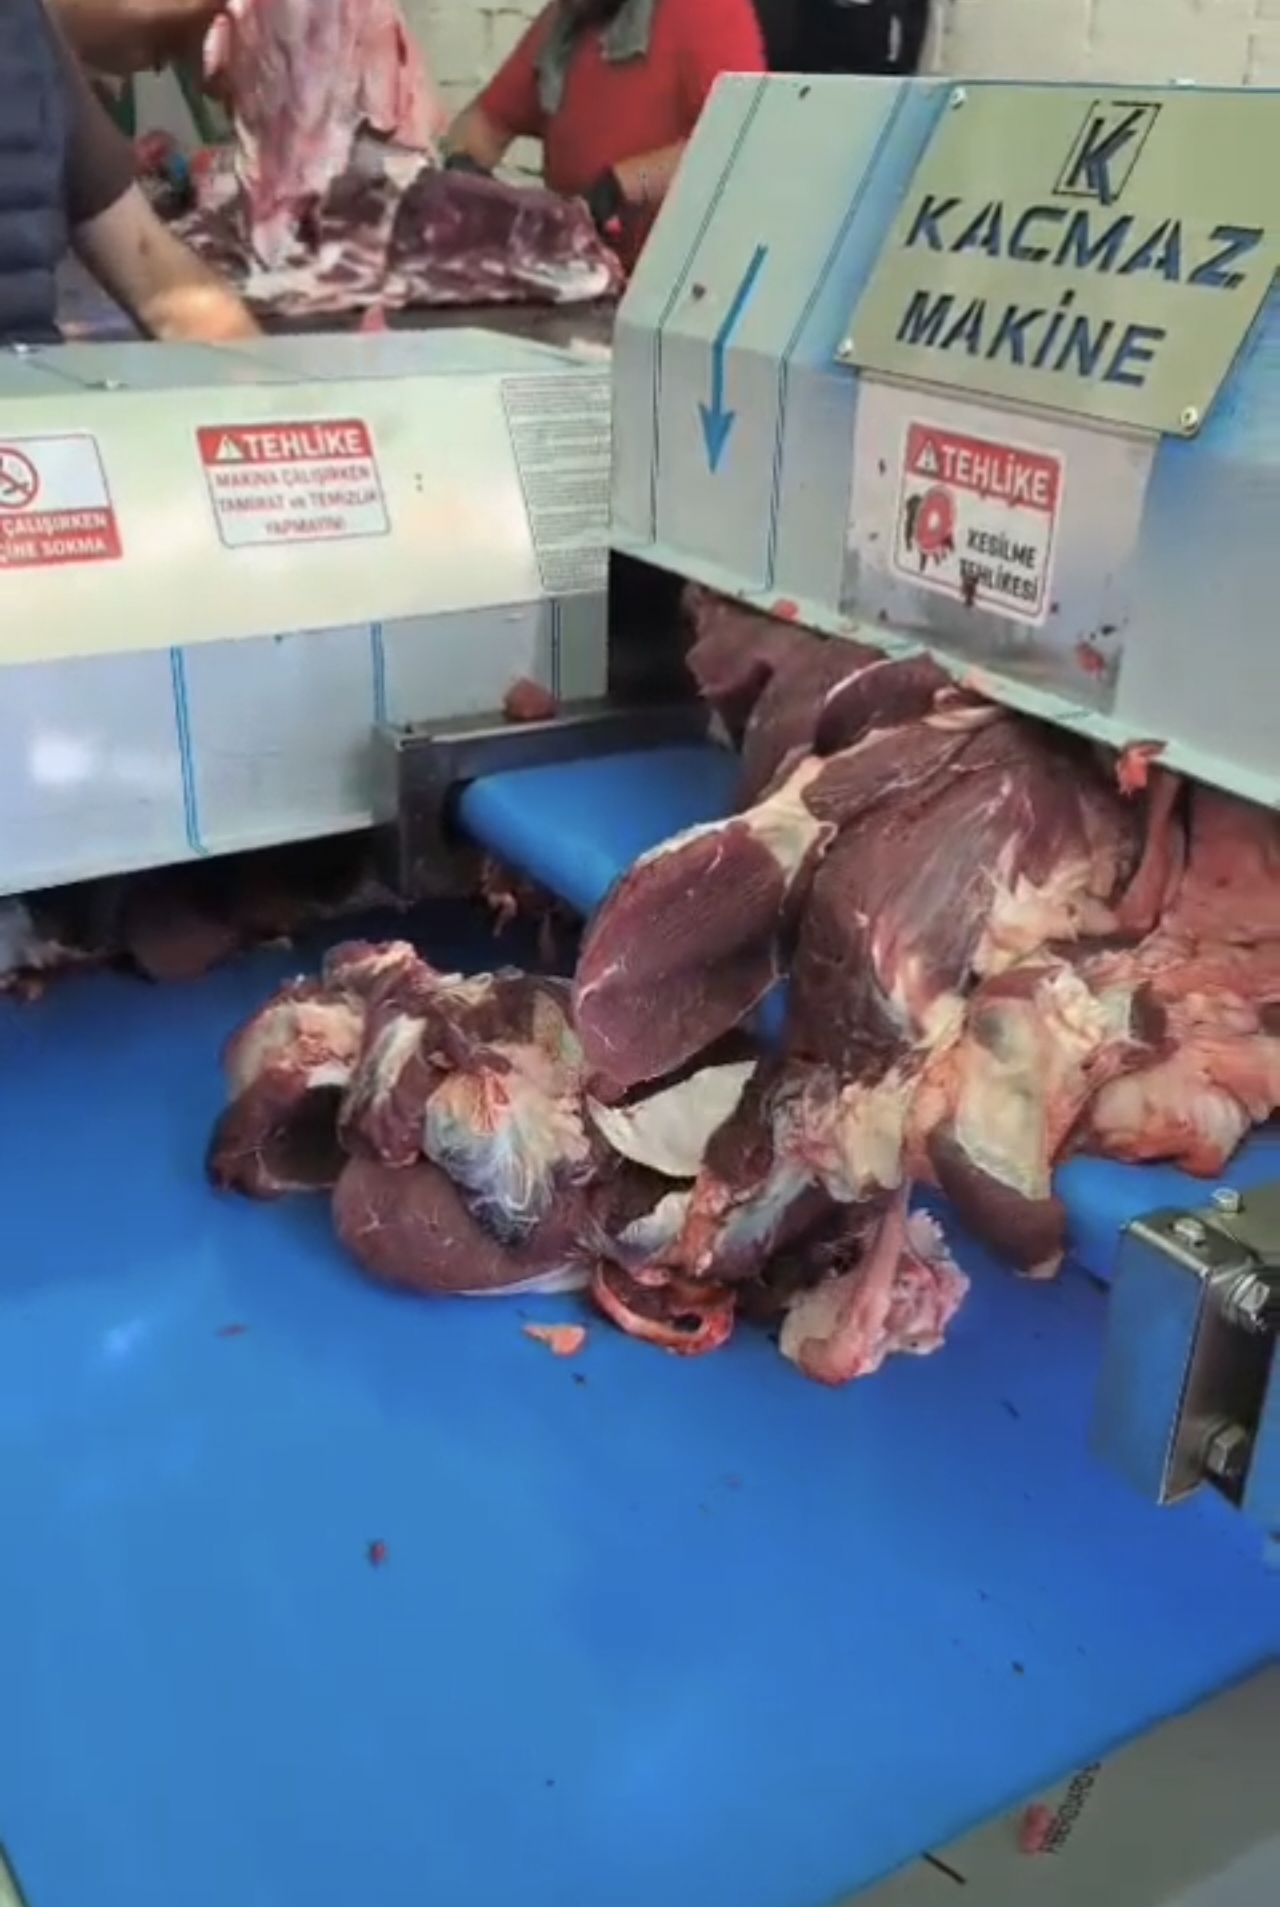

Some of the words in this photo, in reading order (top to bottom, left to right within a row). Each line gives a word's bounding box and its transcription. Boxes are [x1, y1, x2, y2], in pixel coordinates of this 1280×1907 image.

[896, 289, 1166, 387] MAKİNE
[243, 425, 362, 460] TEHLİKE
[941, 444, 1049, 503] TEHLİKE
[289, 495, 308, 508] ve
[1, 512, 107, 538] ÇALIŞIRKEN
[41, 536, 108, 558] SOKMA
[966, 527, 1036, 570] KESİLME
